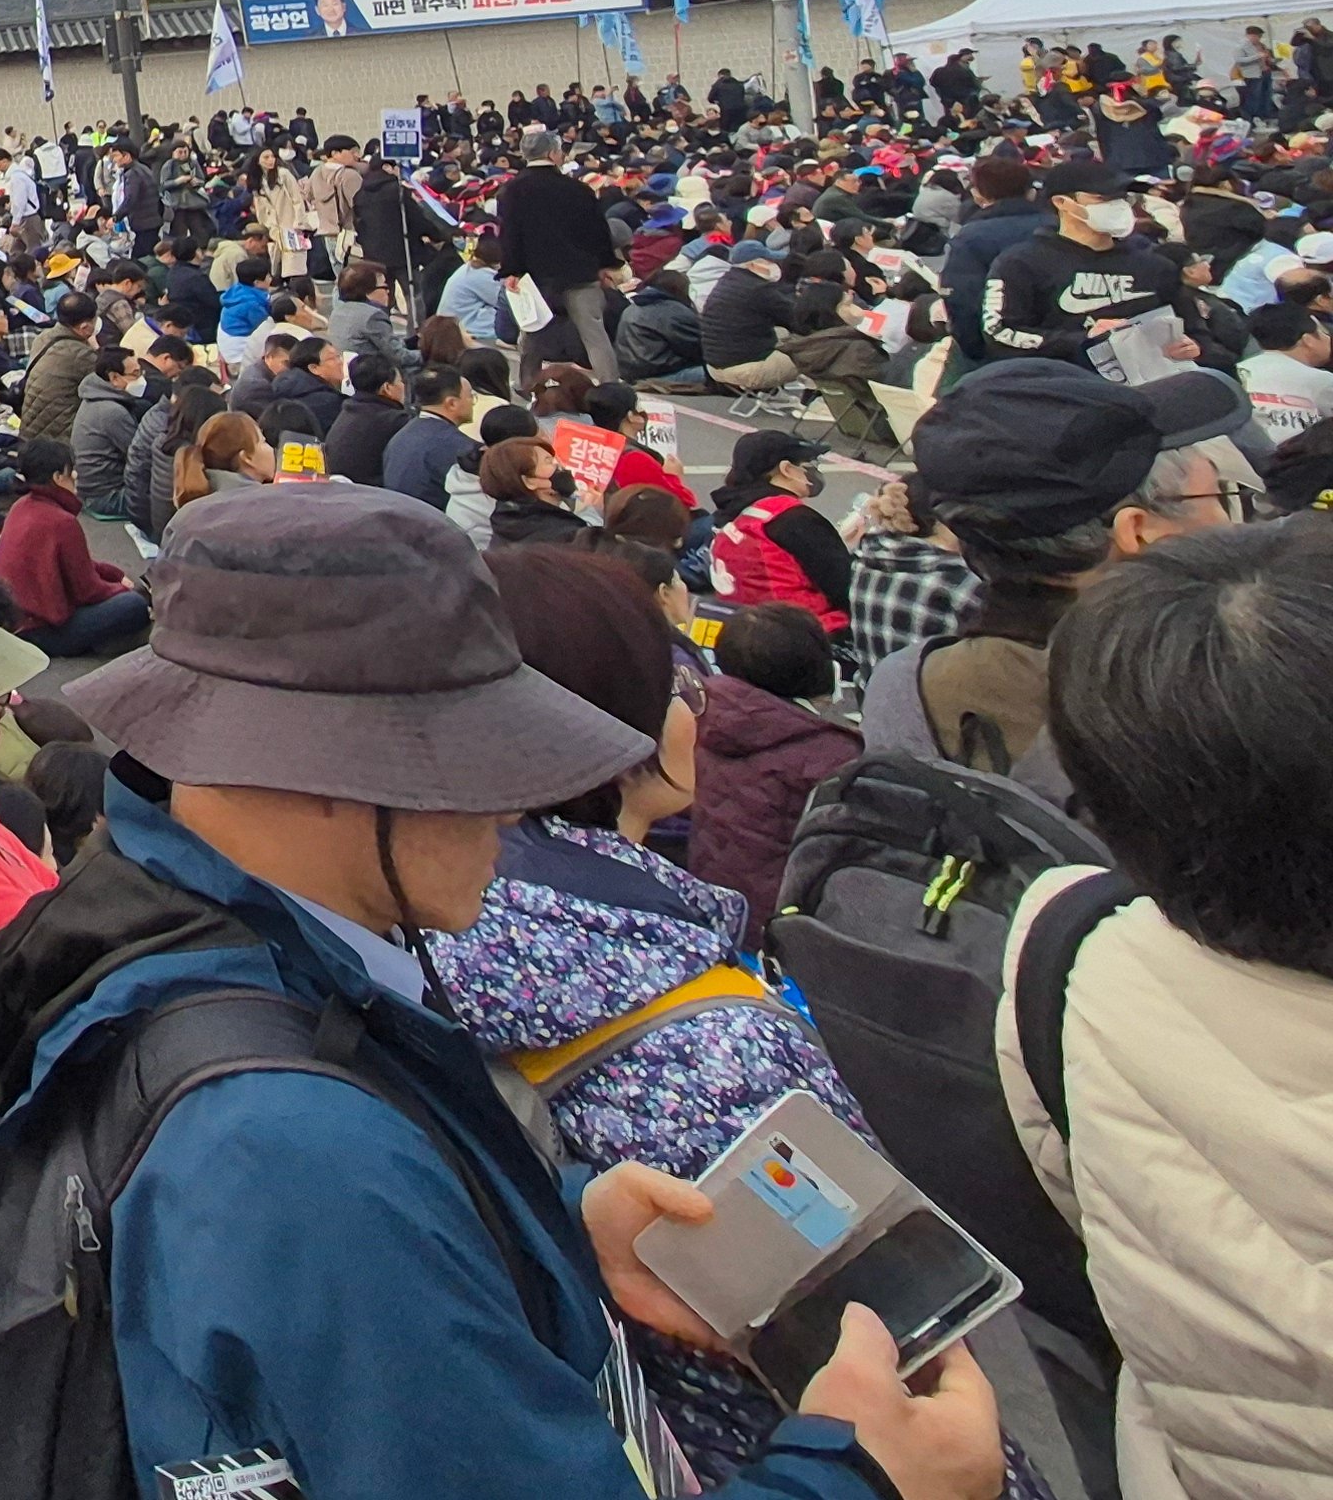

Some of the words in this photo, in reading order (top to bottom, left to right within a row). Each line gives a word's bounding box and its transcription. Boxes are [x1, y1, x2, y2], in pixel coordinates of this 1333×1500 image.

[249, 10, 310, 32] 곽상언
[385, 119, 416, 129] 민주당
[1072, 271, 1136, 304] NIKE
